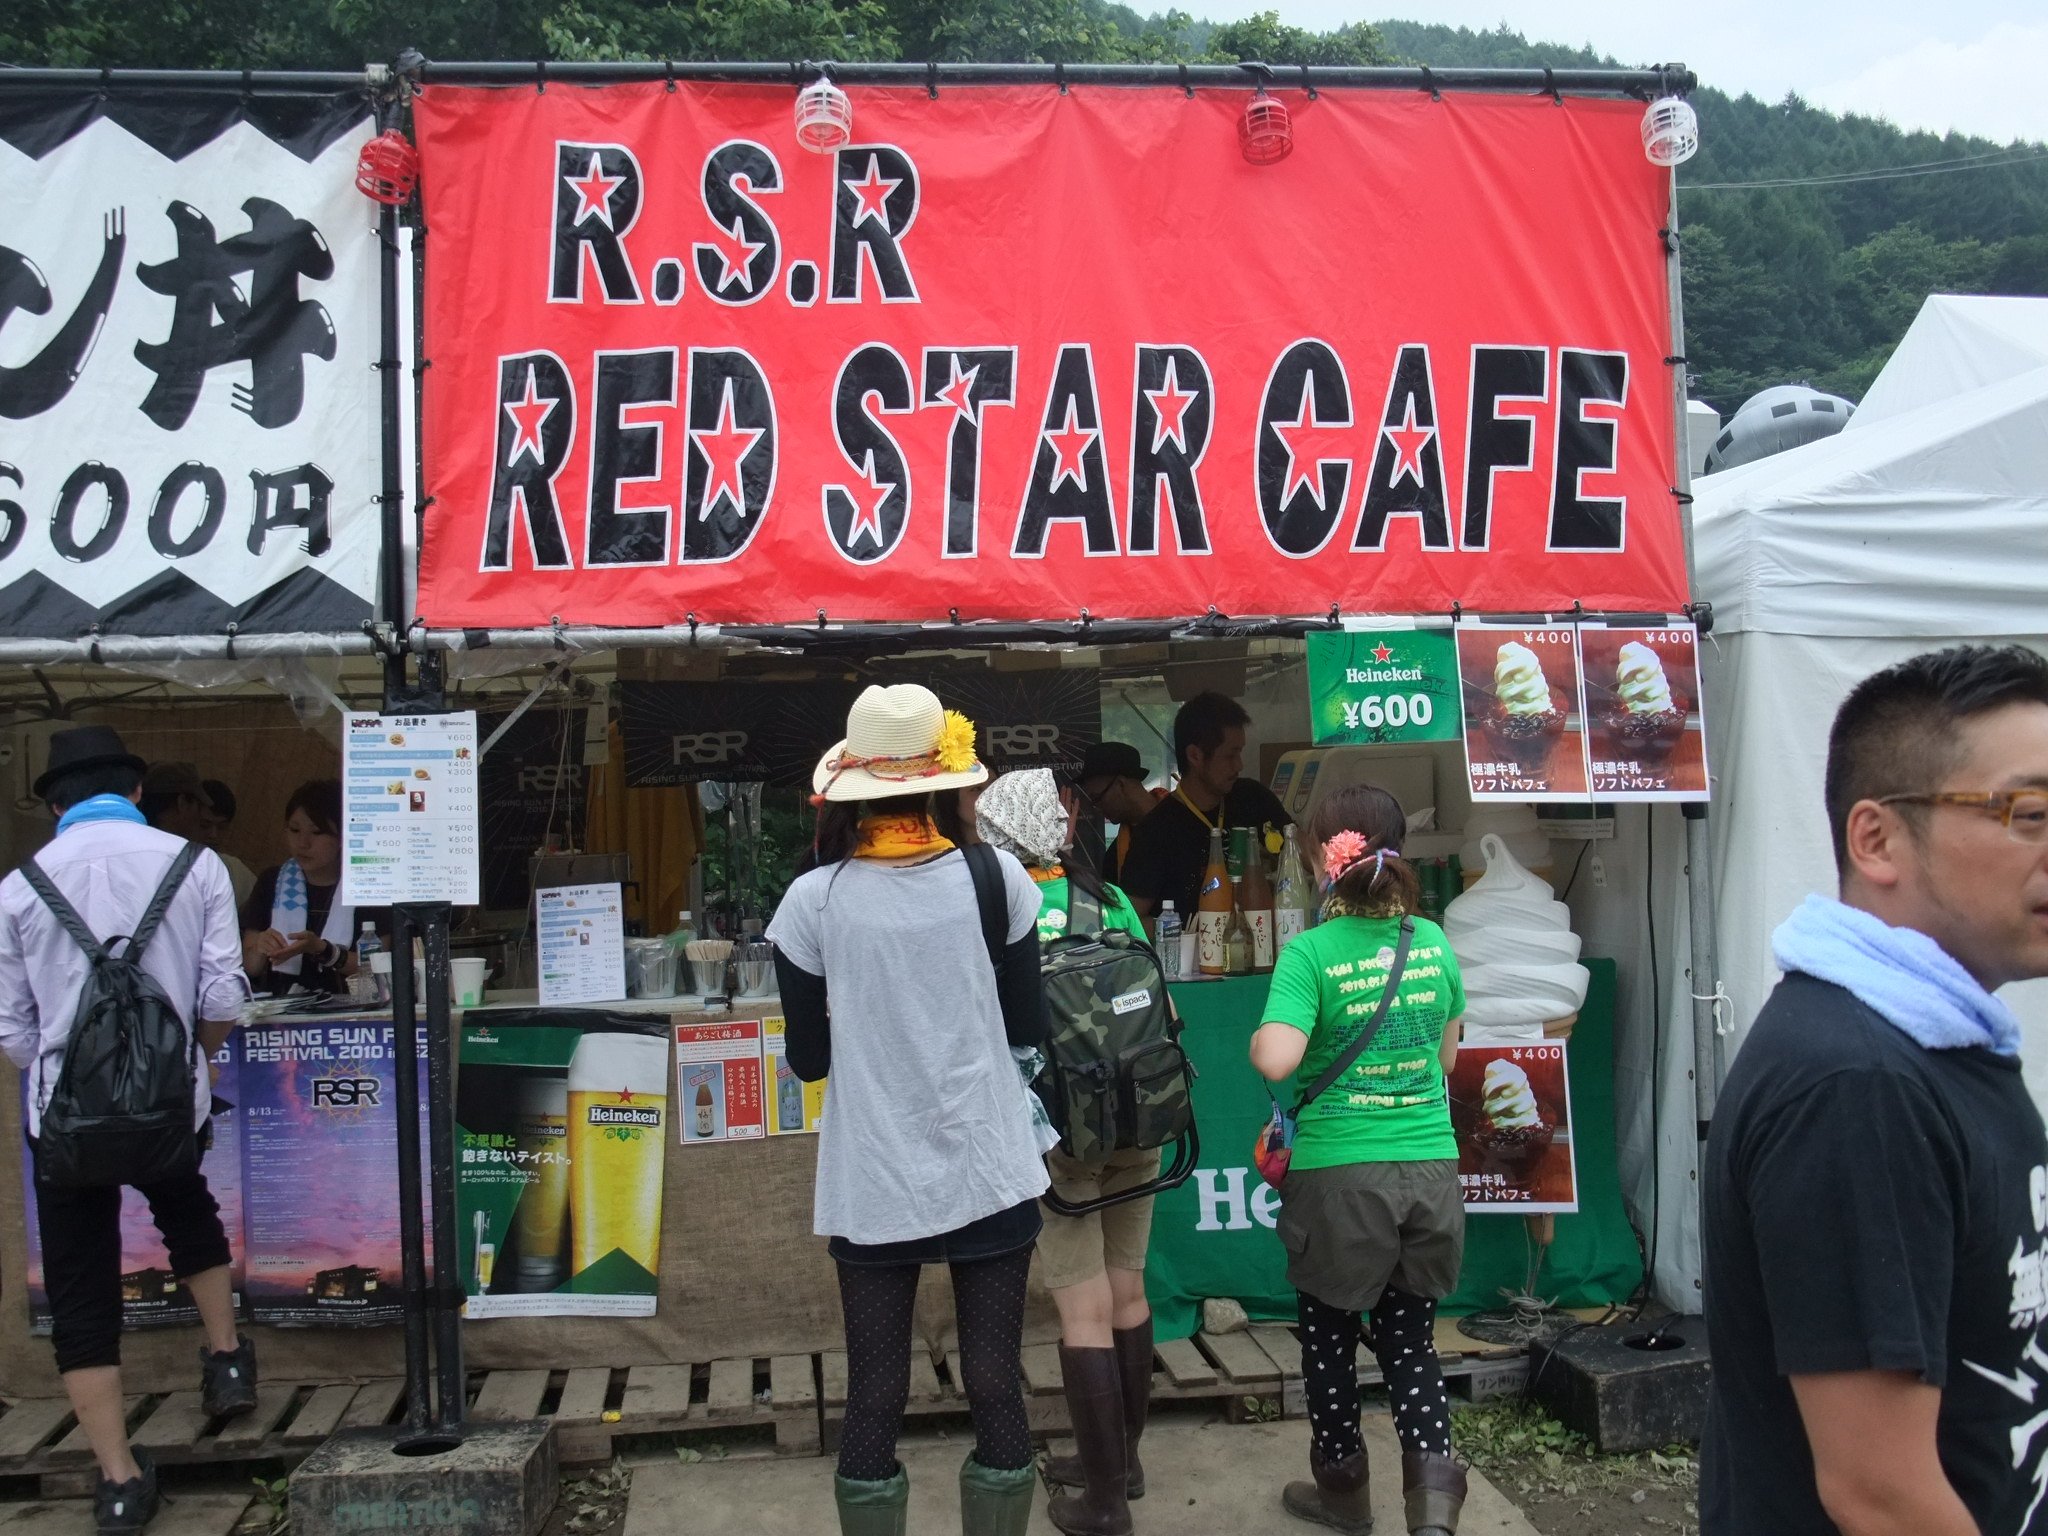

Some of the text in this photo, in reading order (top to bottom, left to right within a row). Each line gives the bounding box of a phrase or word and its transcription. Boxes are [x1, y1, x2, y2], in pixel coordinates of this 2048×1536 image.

[546, 139, 922, 307] R.S.R
[478, 337, 1629, 573] RED STAR CAFE
[1523, 631, 1571, 644] ¥400
[1645, 631, 1692, 644] ¥400
[1346, 667, 1422, 683] Heineken
[1342, 693, 1433, 729] ¥600
[672, 730, 749, 766] RSR
[986, 724, 1060, 757] RSR
[1121, 992, 1148, 1007] ispack
[245, 1029, 322, 1047] RISING
[329, 1028, 376, 1045] SUN
[468, 1035, 499, 1044] Heineken
[246, 1046, 335, 1062] FESTIVAL
[339, 1045, 383, 1059] 2010
[1512, 1048, 1561, 1060] ¥400
[313, 1078, 381, 1107] RSR
[249, 1106, 271, 1116] 8/13
[590, 1107, 658, 1124] Heineken
[462, 1133, 516, 1148] 不思議と
[462, 1150, 573, 1165] 飽きないテイスト。
